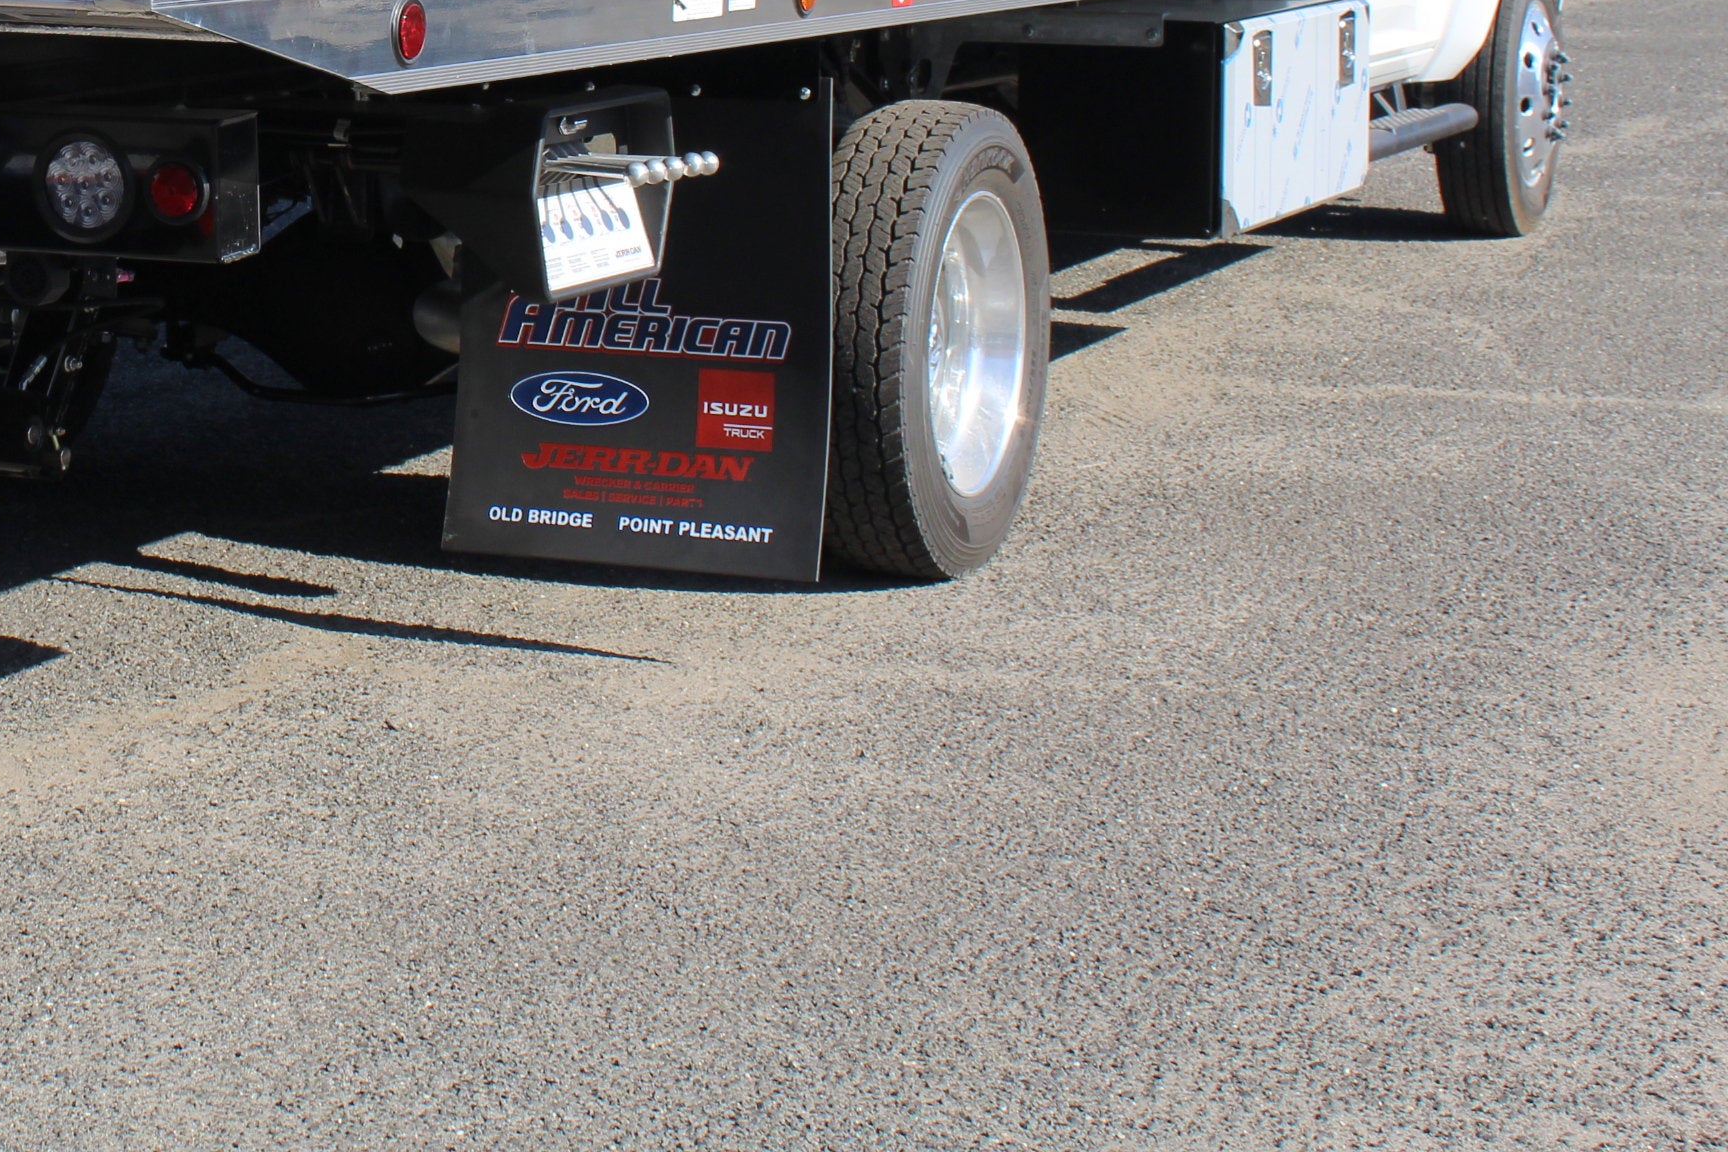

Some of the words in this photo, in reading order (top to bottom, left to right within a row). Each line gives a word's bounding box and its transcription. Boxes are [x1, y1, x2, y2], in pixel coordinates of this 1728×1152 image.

[497, 291, 792, 363] AMERICAN
[531, 378, 629, 416] Ford
[703, 401, 768, 418] ISUZU
[723, 427, 766, 440] TRUCK
[521, 442, 755, 482] JERR-DAN
[562, 488, 599, 501] SALES
[608, 492, 657, 506] SERVICE
[574, 475, 631, 489] WRECKER
[644, 480, 696, 494] CARRIER
[489, 506, 523, 523] OLD
[527, 509, 594, 529] BRIDGE
[618, 516, 674, 535] POINT
[678, 521, 774, 544] PLEASANT
